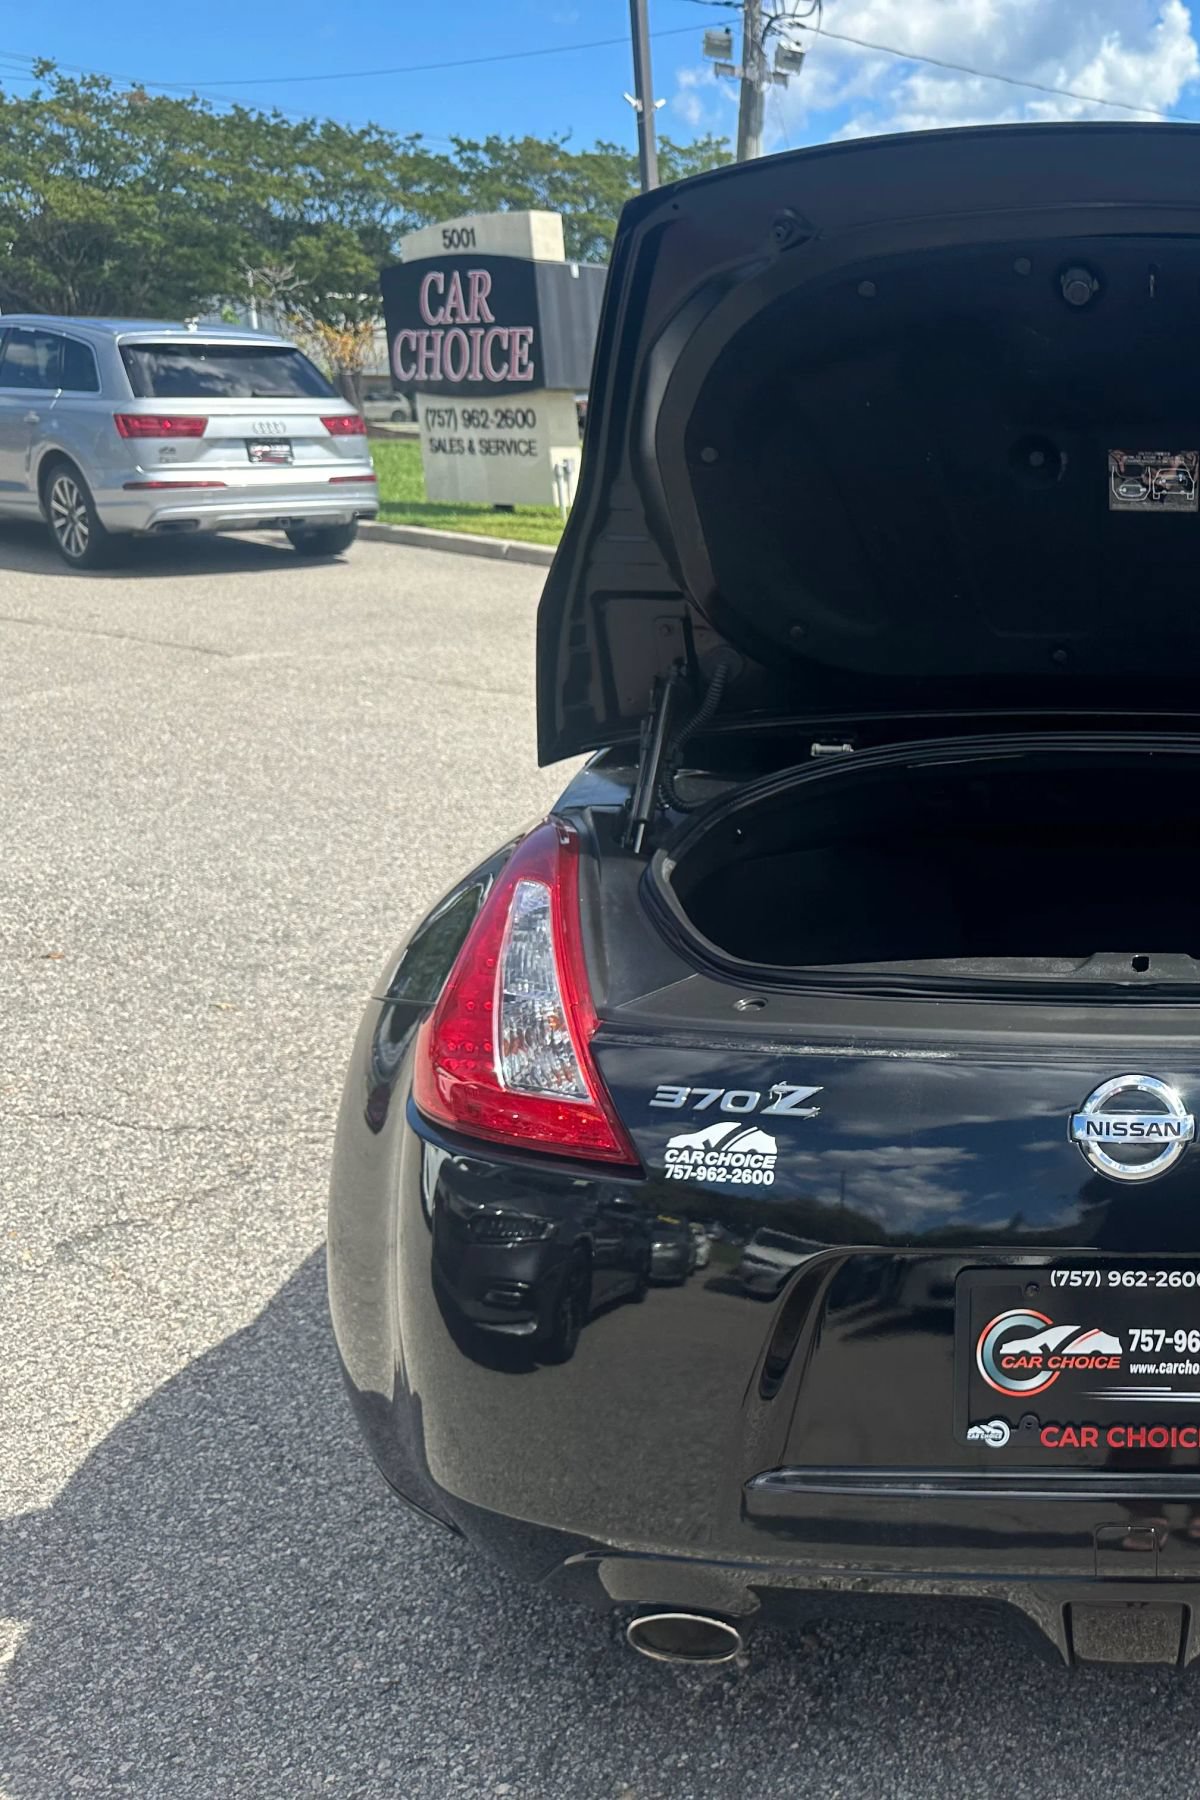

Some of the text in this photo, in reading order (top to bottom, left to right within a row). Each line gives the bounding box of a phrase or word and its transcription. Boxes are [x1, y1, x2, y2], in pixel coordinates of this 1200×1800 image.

[442, 227, 477, 249] 5001
[419, 269, 495, 326] CAR
[393, 326, 534, 383] CHOICE
[425, 408, 537, 432] (757) 962-2600
[429, 438, 538, 457] SALES & SERVICE
[1086, 1121, 1181, 1137] NISSAN
[664, 1164, 775, 1185] 757-962-2600
[1050, 1270, 1101, 1288] (757)
[1001, 1356, 1121, 1370] CAR CHOICE
[1040, 1427, 1098, 1448] CAR
